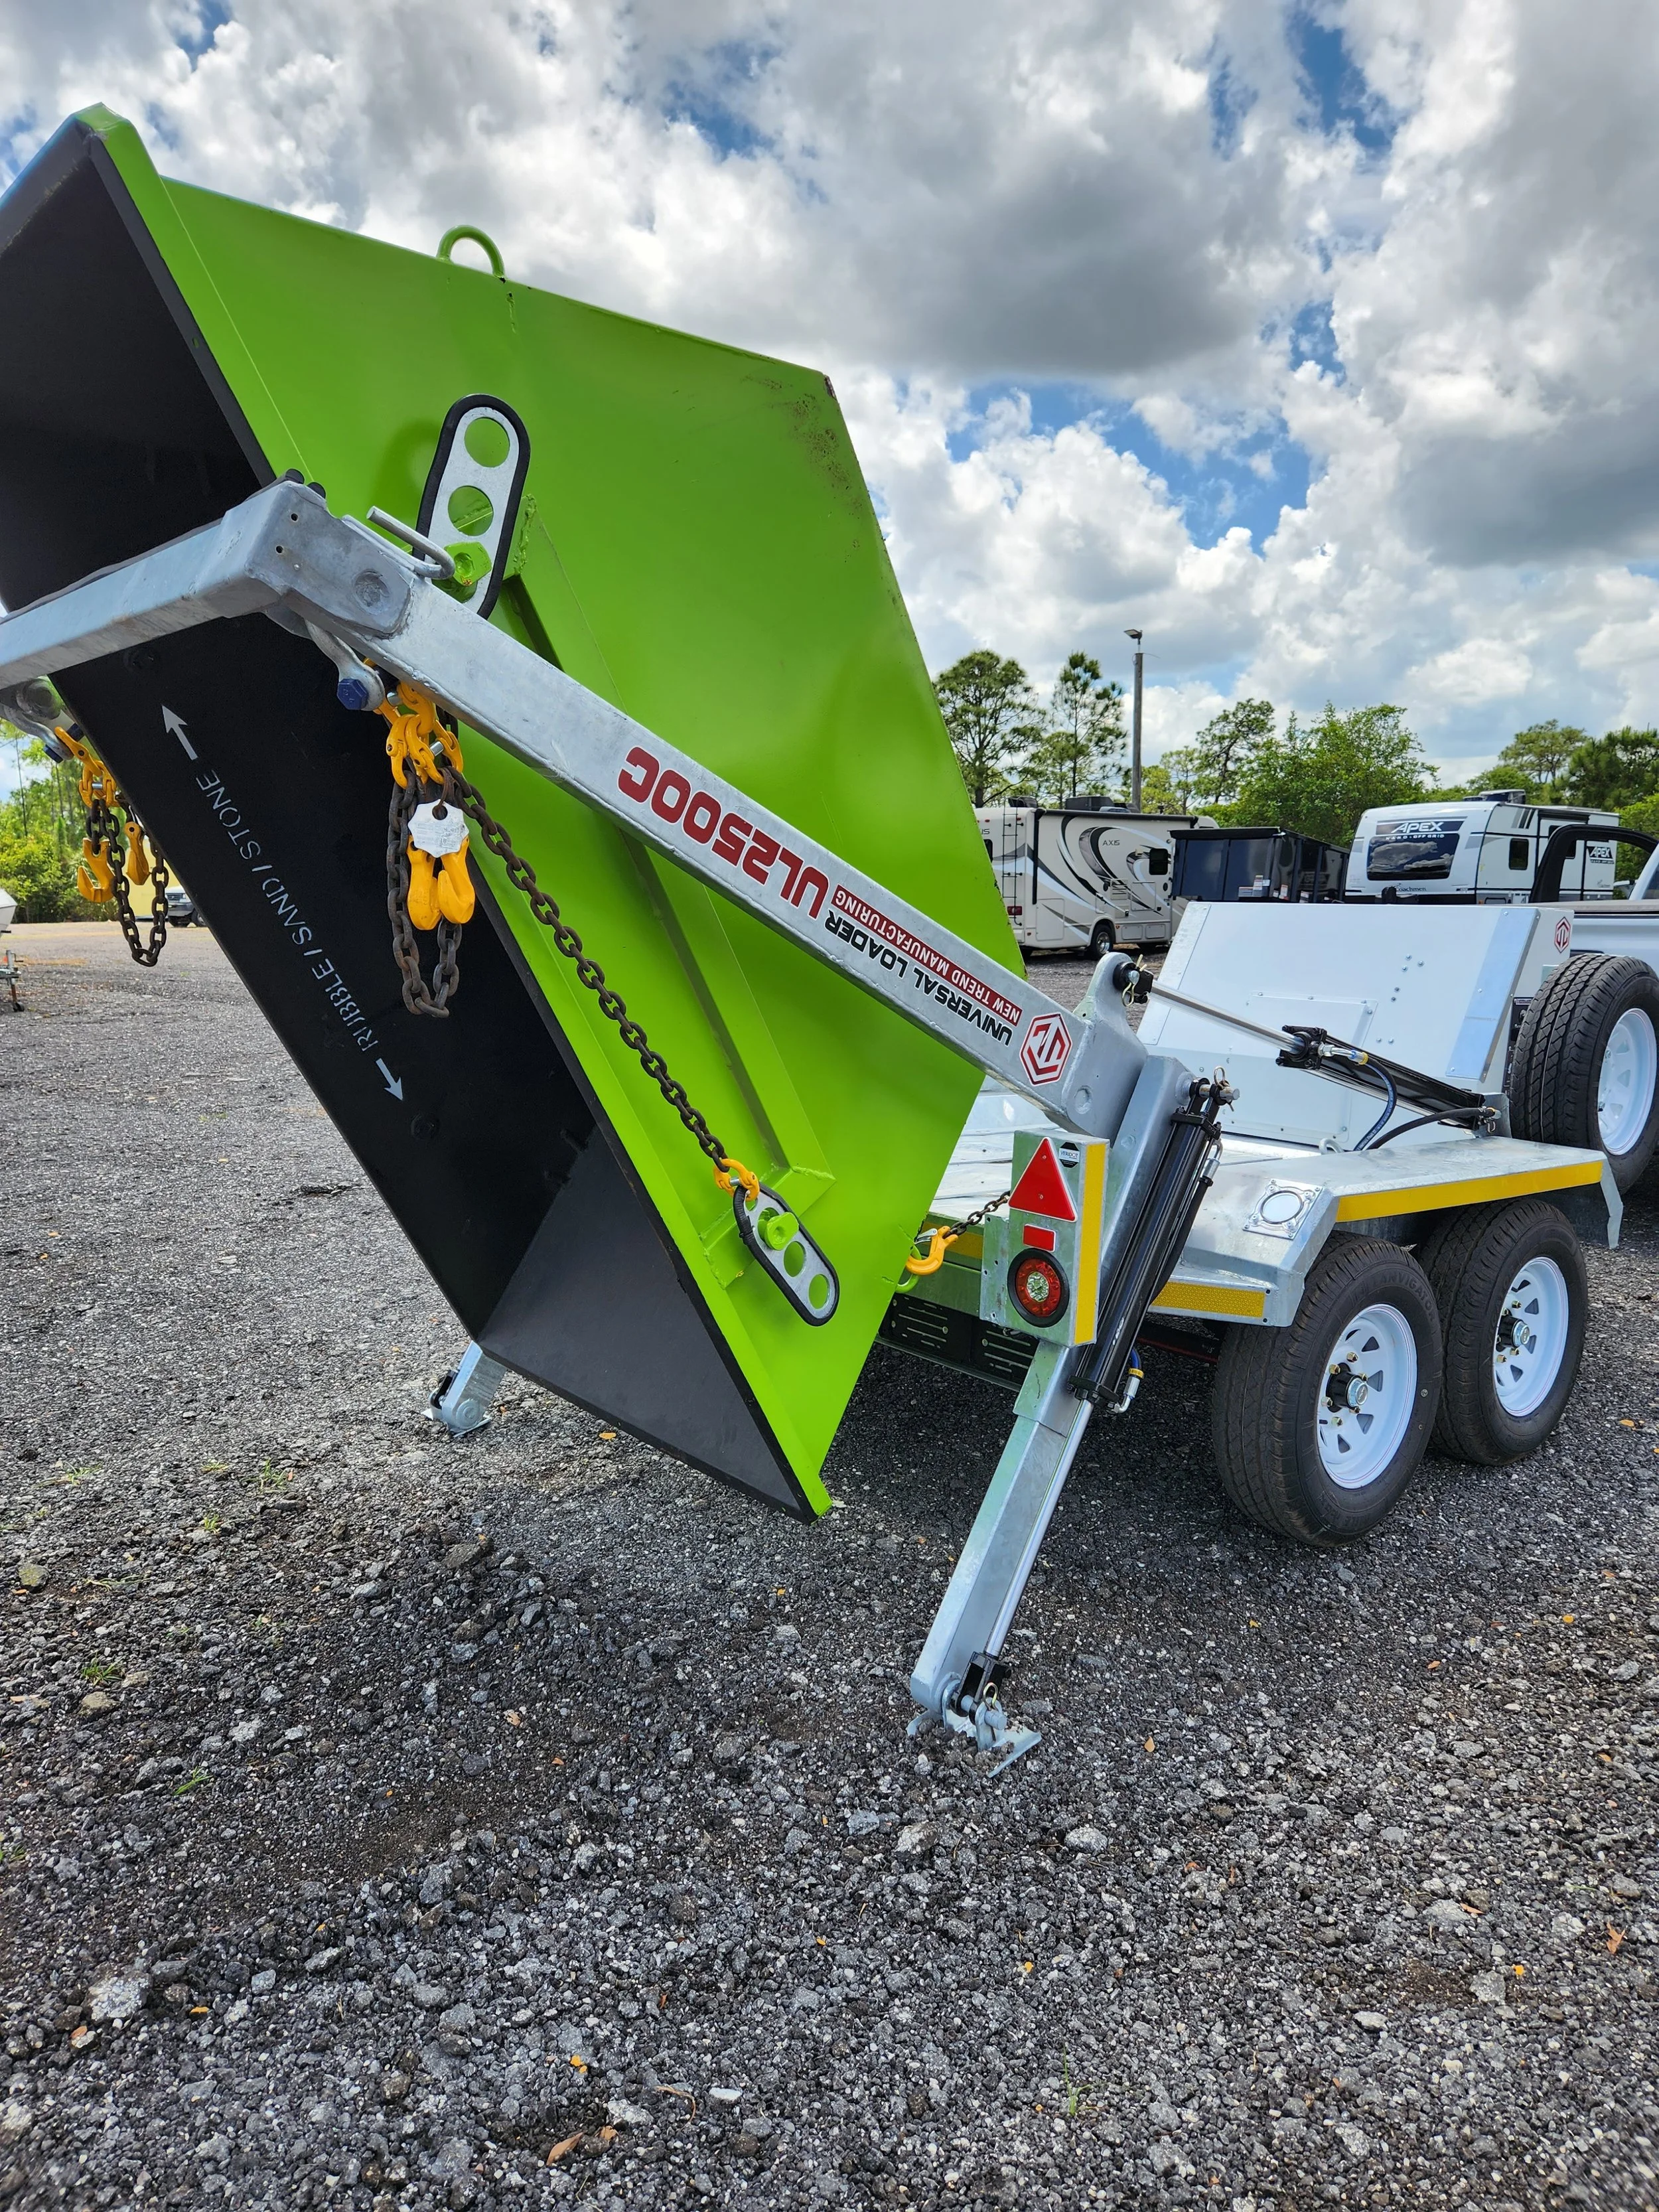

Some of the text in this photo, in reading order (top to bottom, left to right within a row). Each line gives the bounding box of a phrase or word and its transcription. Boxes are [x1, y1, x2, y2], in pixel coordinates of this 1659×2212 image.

[196, 769, 260, 859] STONE
[618, 747, 829, 919] UL2500C
[1391, 822, 1444, 834] APEX
[1590, 846, 1611, 857] APEX
[262, 877, 312, 945] SAND
[835, 890, 1020, 1023] NEW TREND MANUFACTURING
[313, 958, 379, 1052] RUBBLE
[825, 910, 1013, 1047] UNIVERSAL LOADER
